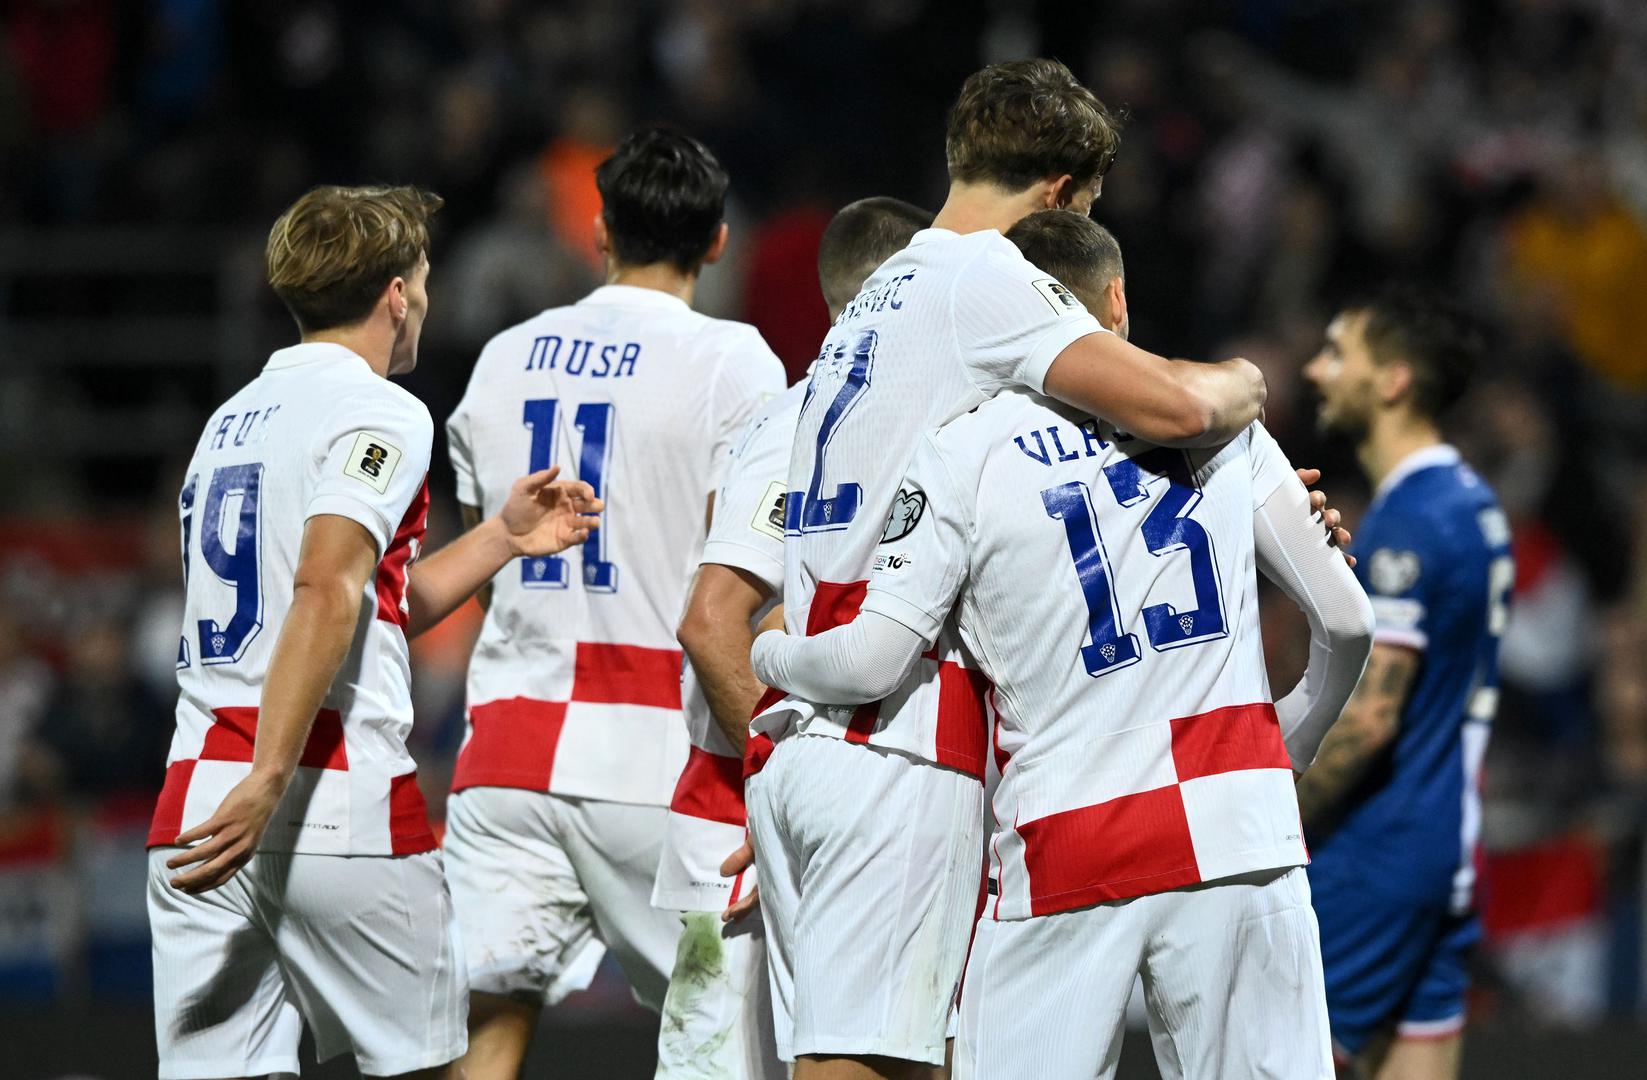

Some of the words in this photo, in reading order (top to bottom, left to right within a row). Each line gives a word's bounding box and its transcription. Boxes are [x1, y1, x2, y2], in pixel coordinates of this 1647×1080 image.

[525, 335, 641, 378] MUSA
[521, 398, 620, 594] 11
[1040, 446, 1230, 678] 13
